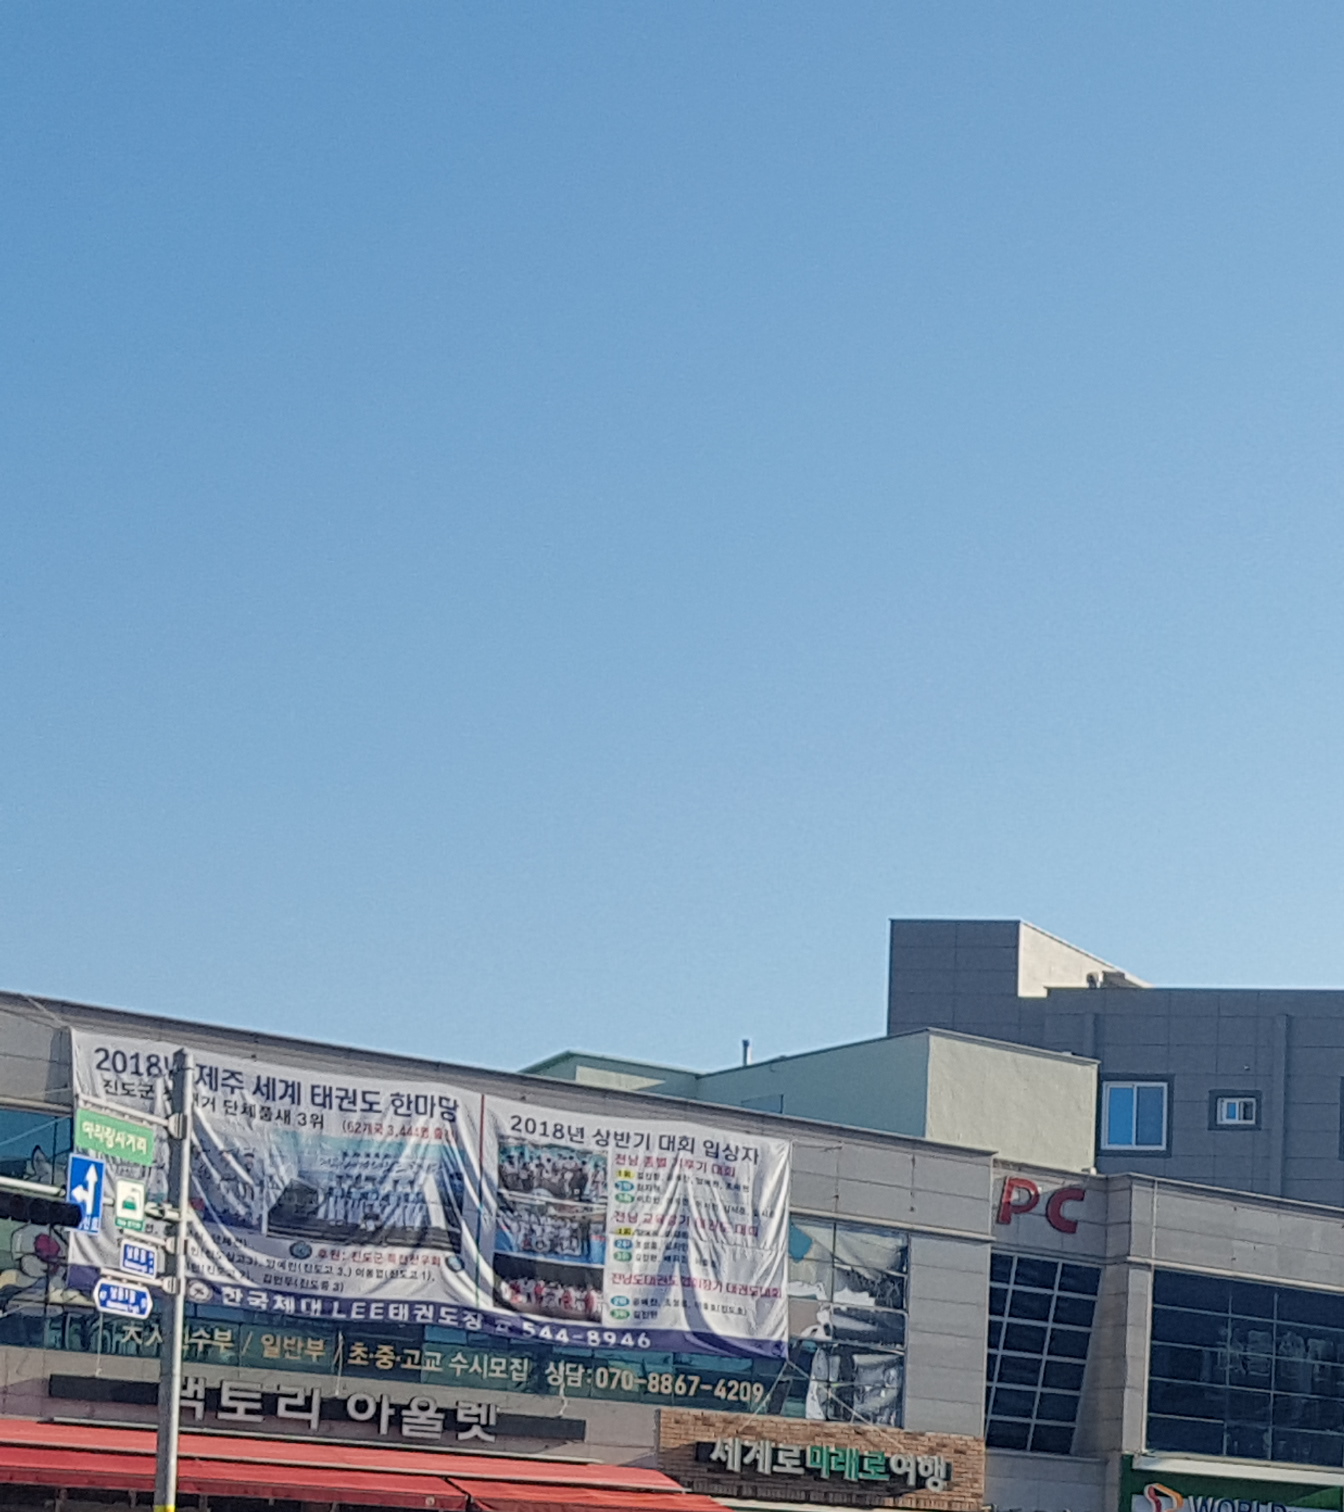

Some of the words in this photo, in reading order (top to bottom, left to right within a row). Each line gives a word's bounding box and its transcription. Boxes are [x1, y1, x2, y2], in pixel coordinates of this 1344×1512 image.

[95, 1048, 171, 1077] 2018
[196, 1064, 244, 1094] 제주
[252, 1075, 301, 1106] 세계
[310, 1084, 382, 1114] 태권도
[390, 1091, 460, 1122] 한마당
[82, 1121, 148, 1154] 아리랑사거리
[297, 1112, 324, 1130] 3위
[510, 1115, 585, 1144] 2018년
[592, 1129, 650, 1151] 상반기
[659, 1134, 696, 1155] 대회
[703, 1140, 759, 1165] 입상자
[996, 1175, 1086, 1234] PC
[221, 1286, 326, 1315] 한국체대
[332, 1299, 484, 1330] LEE태권도장
[522, 1322, 651, 1349] 544-8946
[260, 1333, 326, 1362] 일반부
[448, 1350, 529, 1383] 수시모집
[347, 1393, 501, 1443] 아울렛
